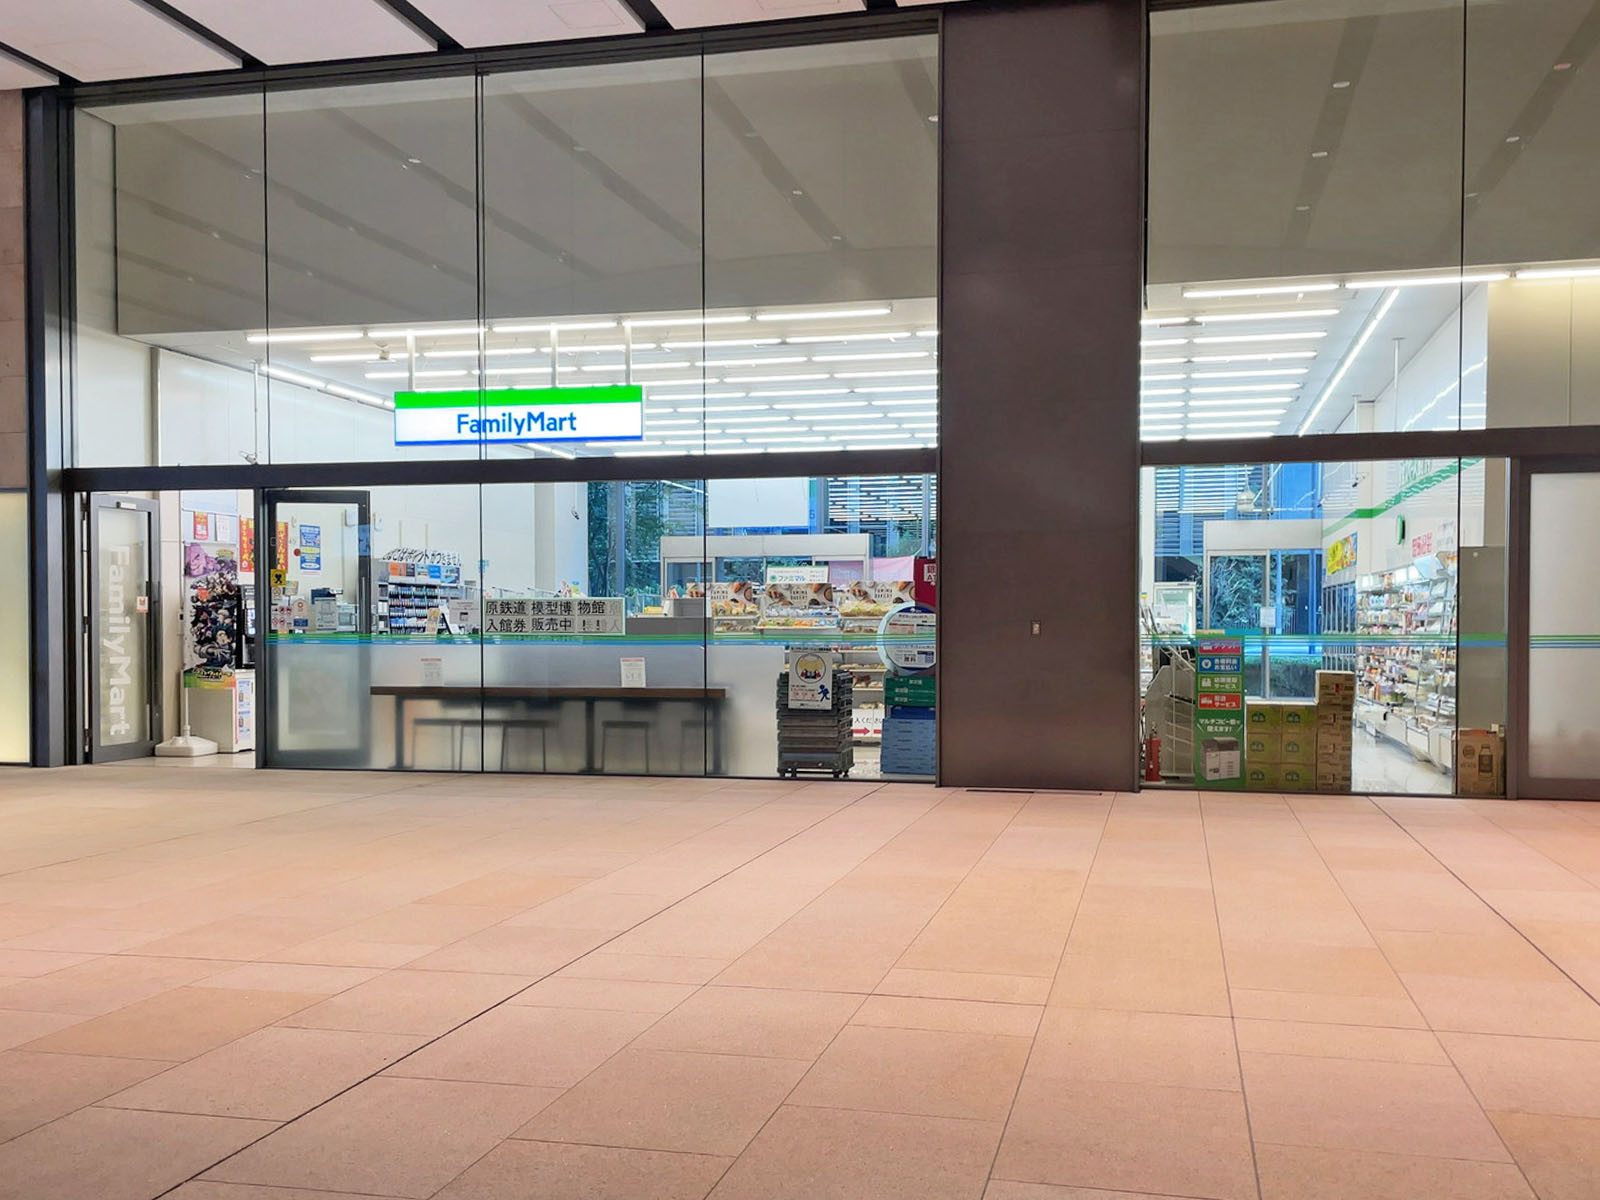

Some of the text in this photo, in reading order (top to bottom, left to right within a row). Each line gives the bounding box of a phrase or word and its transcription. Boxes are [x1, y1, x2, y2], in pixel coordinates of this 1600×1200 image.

[457, 412, 576, 436] FamilyMart
[486, 601, 606, 615] 原鉄道模型博物館
[103, 545, 131, 736] FamilyMart
